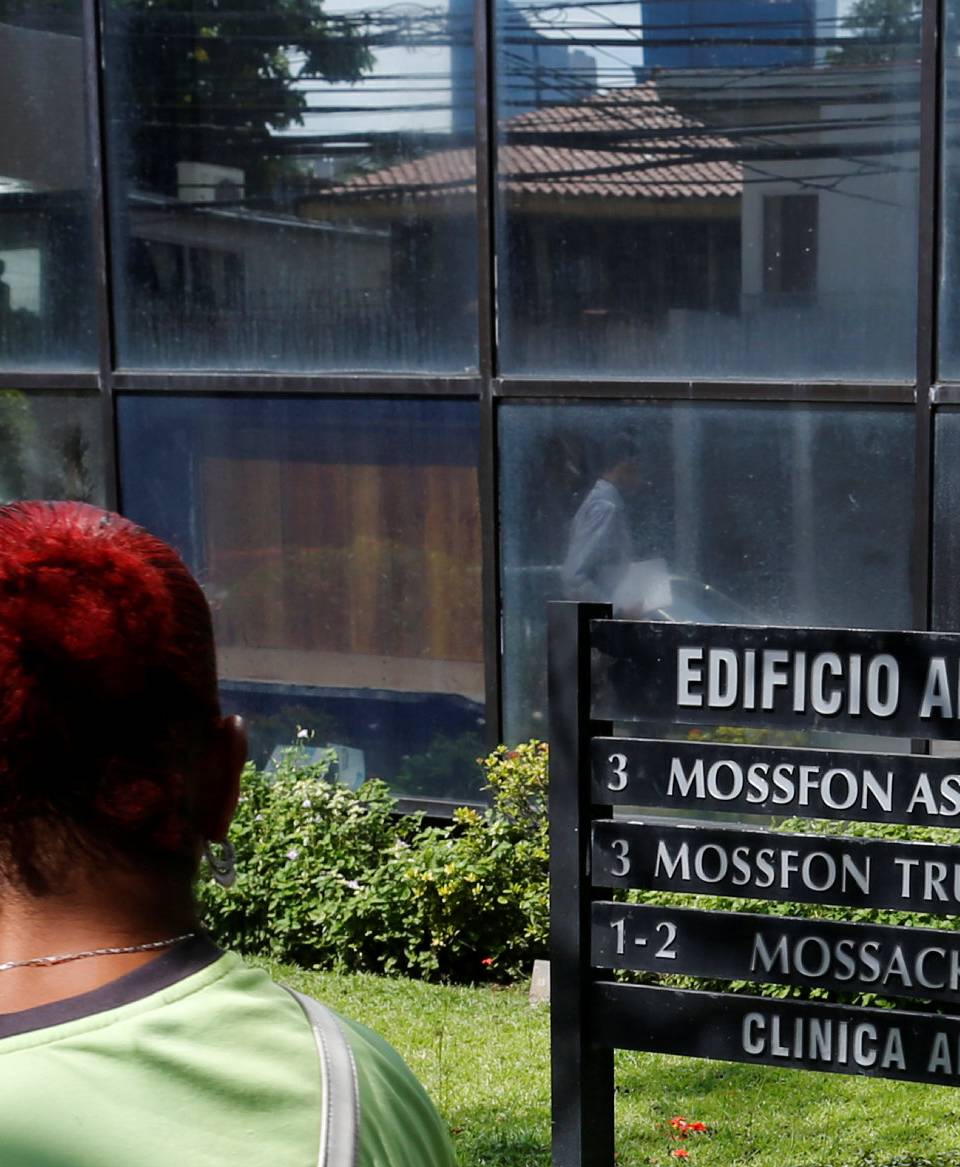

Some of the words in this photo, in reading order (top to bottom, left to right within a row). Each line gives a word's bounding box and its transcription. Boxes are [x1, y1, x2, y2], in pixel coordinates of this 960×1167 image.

[677, 647, 900, 718] EDIFICIO
[607, 752, 629, 792] 3
[667, 757, 894, 814] MOSSFON
[610, 839, 632, 878] 3
[654, 840, 871, 895] MOSSFON
[610, 918, 678, 960] 1-2
[742, 1011, 906, 1071] CLINICA
